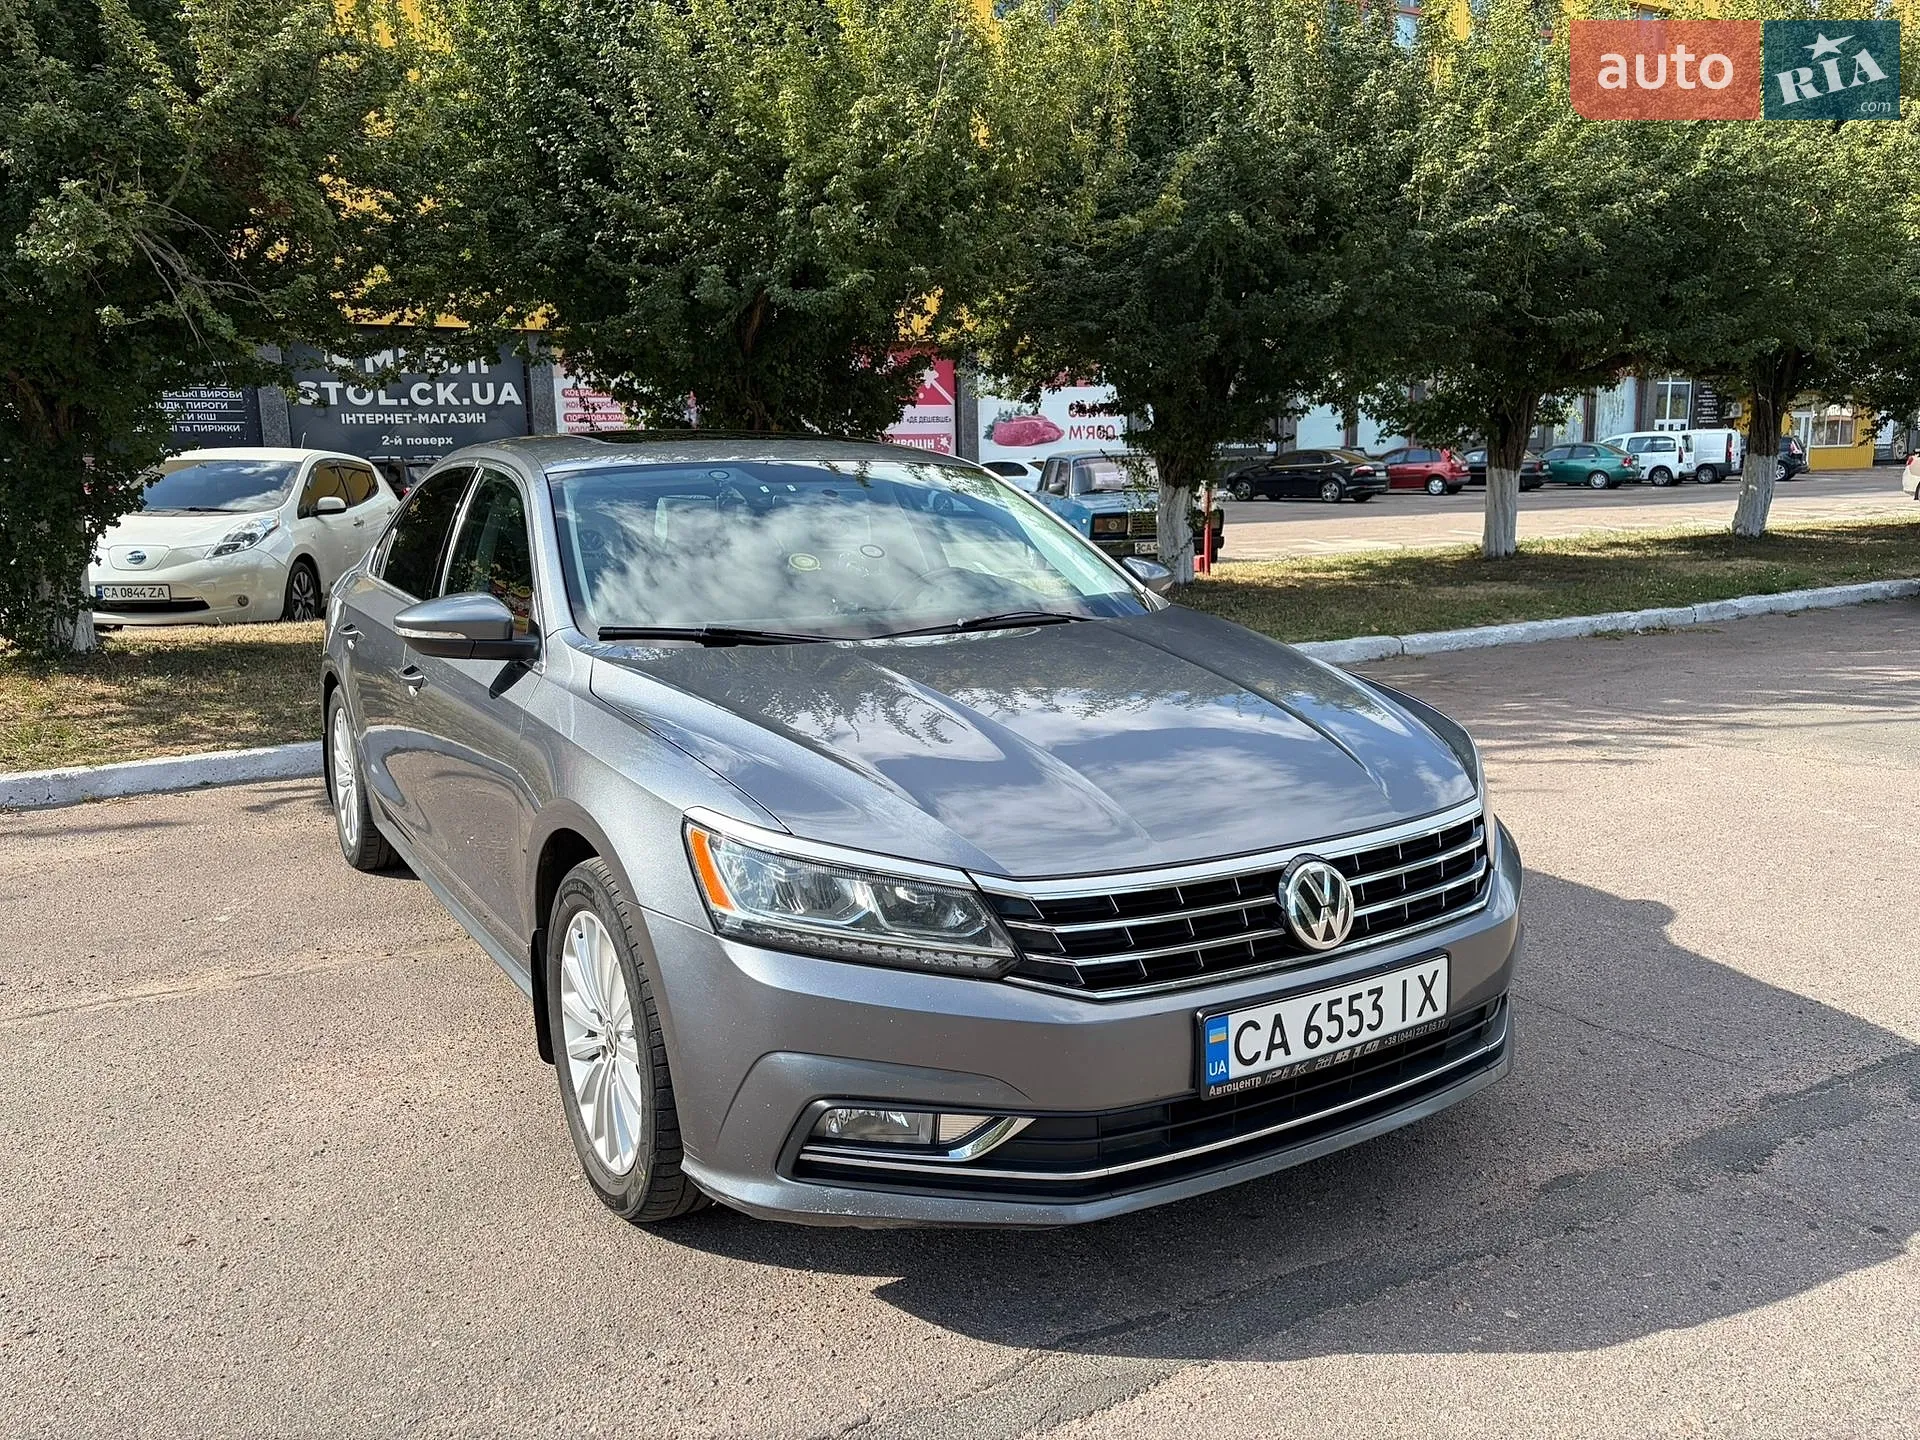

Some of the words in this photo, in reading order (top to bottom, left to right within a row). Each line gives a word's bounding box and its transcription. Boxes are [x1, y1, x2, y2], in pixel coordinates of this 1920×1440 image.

[200, 390, 244, 399] ВИРОБИ
[298, 380, 523, 407] STOL.CK.UA
[186, 401, 229, 410] ПИРОГИ
[196, 413, 217, 421] КІШ
[341, 412, 487, 425] ІНТЕРНЕТ-МАГАЗИН
[192, 424, 241, 433] ПИРІЖКИ
[381, 435, 402, 447] 2-й
[406, 436, 453, 448] поверх
[103, 587, 118, 598] CA
[120, 587, 146, 598] 0844
[147, 587, 166, 598] ZA
[1234, 1013, 1292, 1067] CA
[1303, 985, 1385, 1050] 6553
[1209, 1059, 1227, 1076] UA
[1208, 1075, 1262, 1097] Автоцентр
